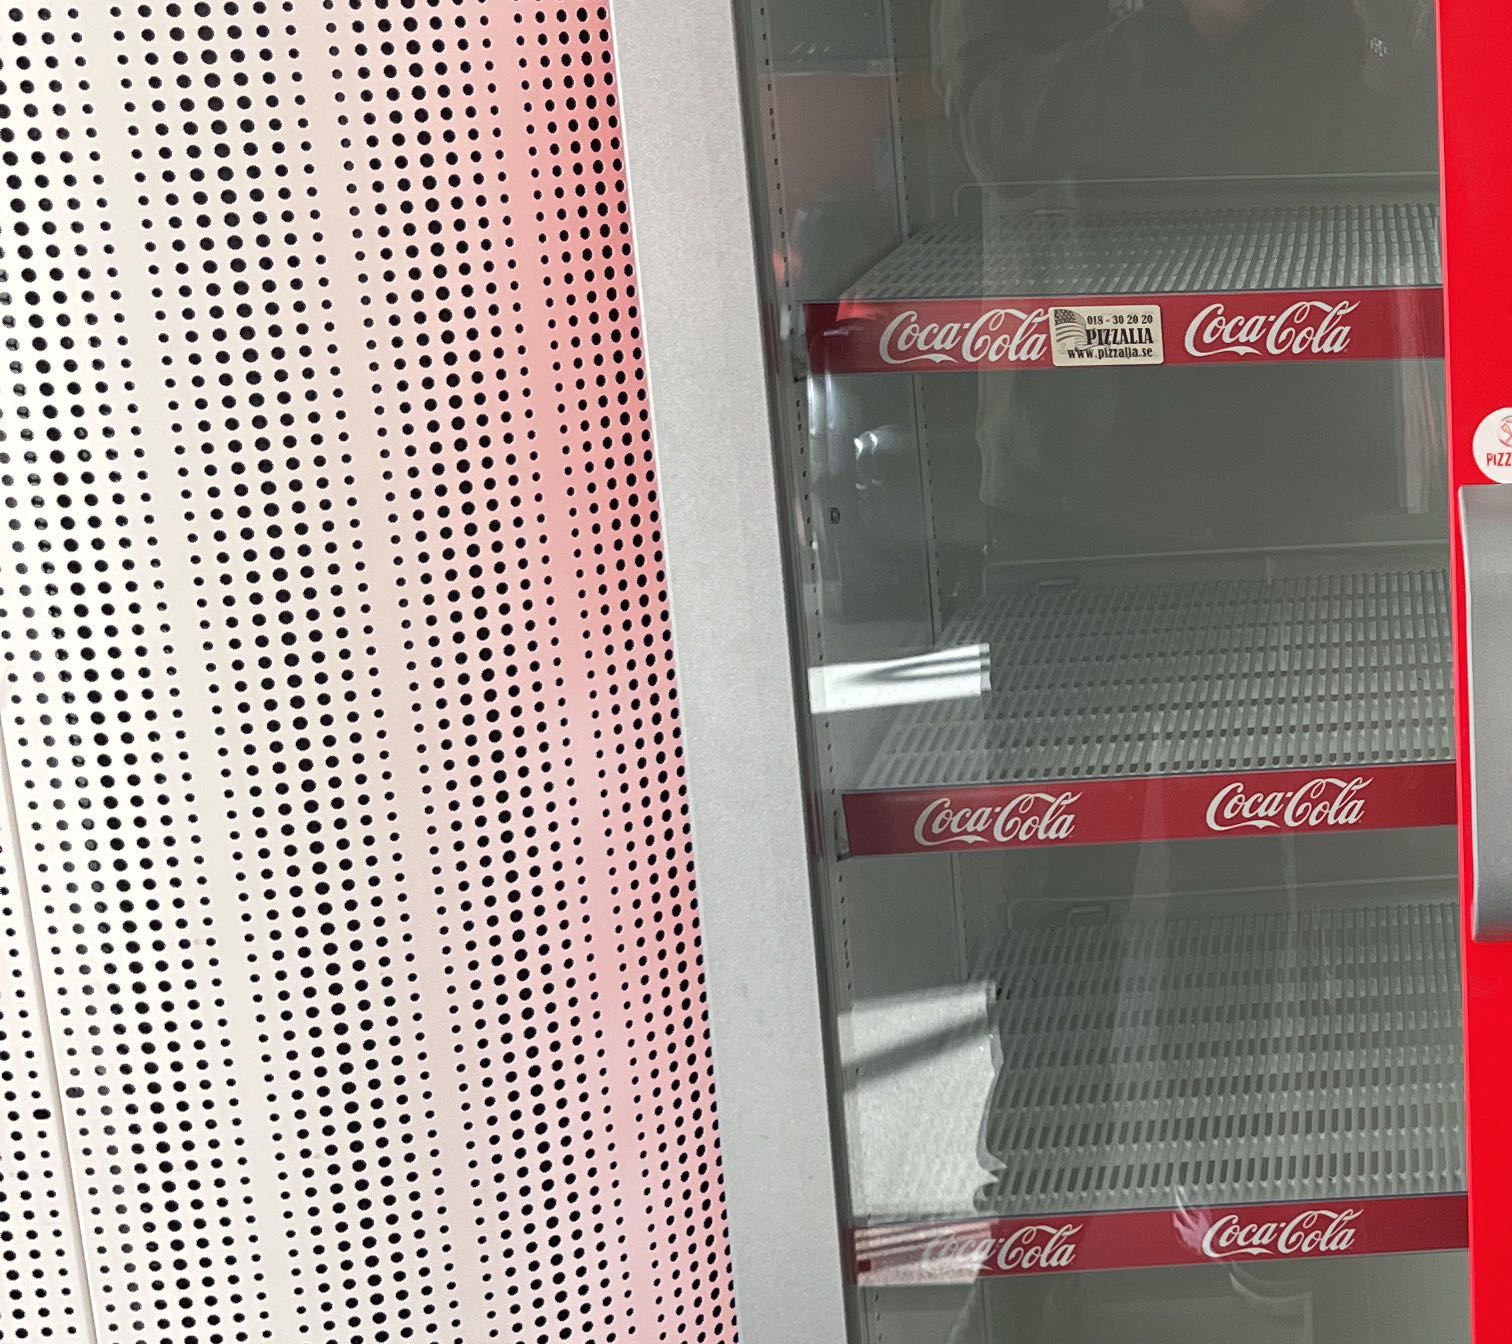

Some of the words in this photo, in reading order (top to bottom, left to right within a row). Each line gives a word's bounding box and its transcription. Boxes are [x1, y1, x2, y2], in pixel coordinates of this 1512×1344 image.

[879, 307, 1050, 365] Coca-Cola
[1086, 327, 1154, 346] PIZZALIA
[1087, 315, 1104, 325] 018
[1112, 314, 1124, 325] 30
[1127, 314, 1139, 325] 20
[1141, 314, 1153, 325] 20
[1184, 300, 1361, 358] Coca-Cola
[1067, 346, 1153, 360] www.pizzalia.se
[913, 790, 1082, 847] Coca-Cola
[1205, 776, 1374, 832] Coca-Cola
[920, 1222, 1084, 1273] Coca-Cola
[1201, 1207, 1365, 1258] Coca-Cola
